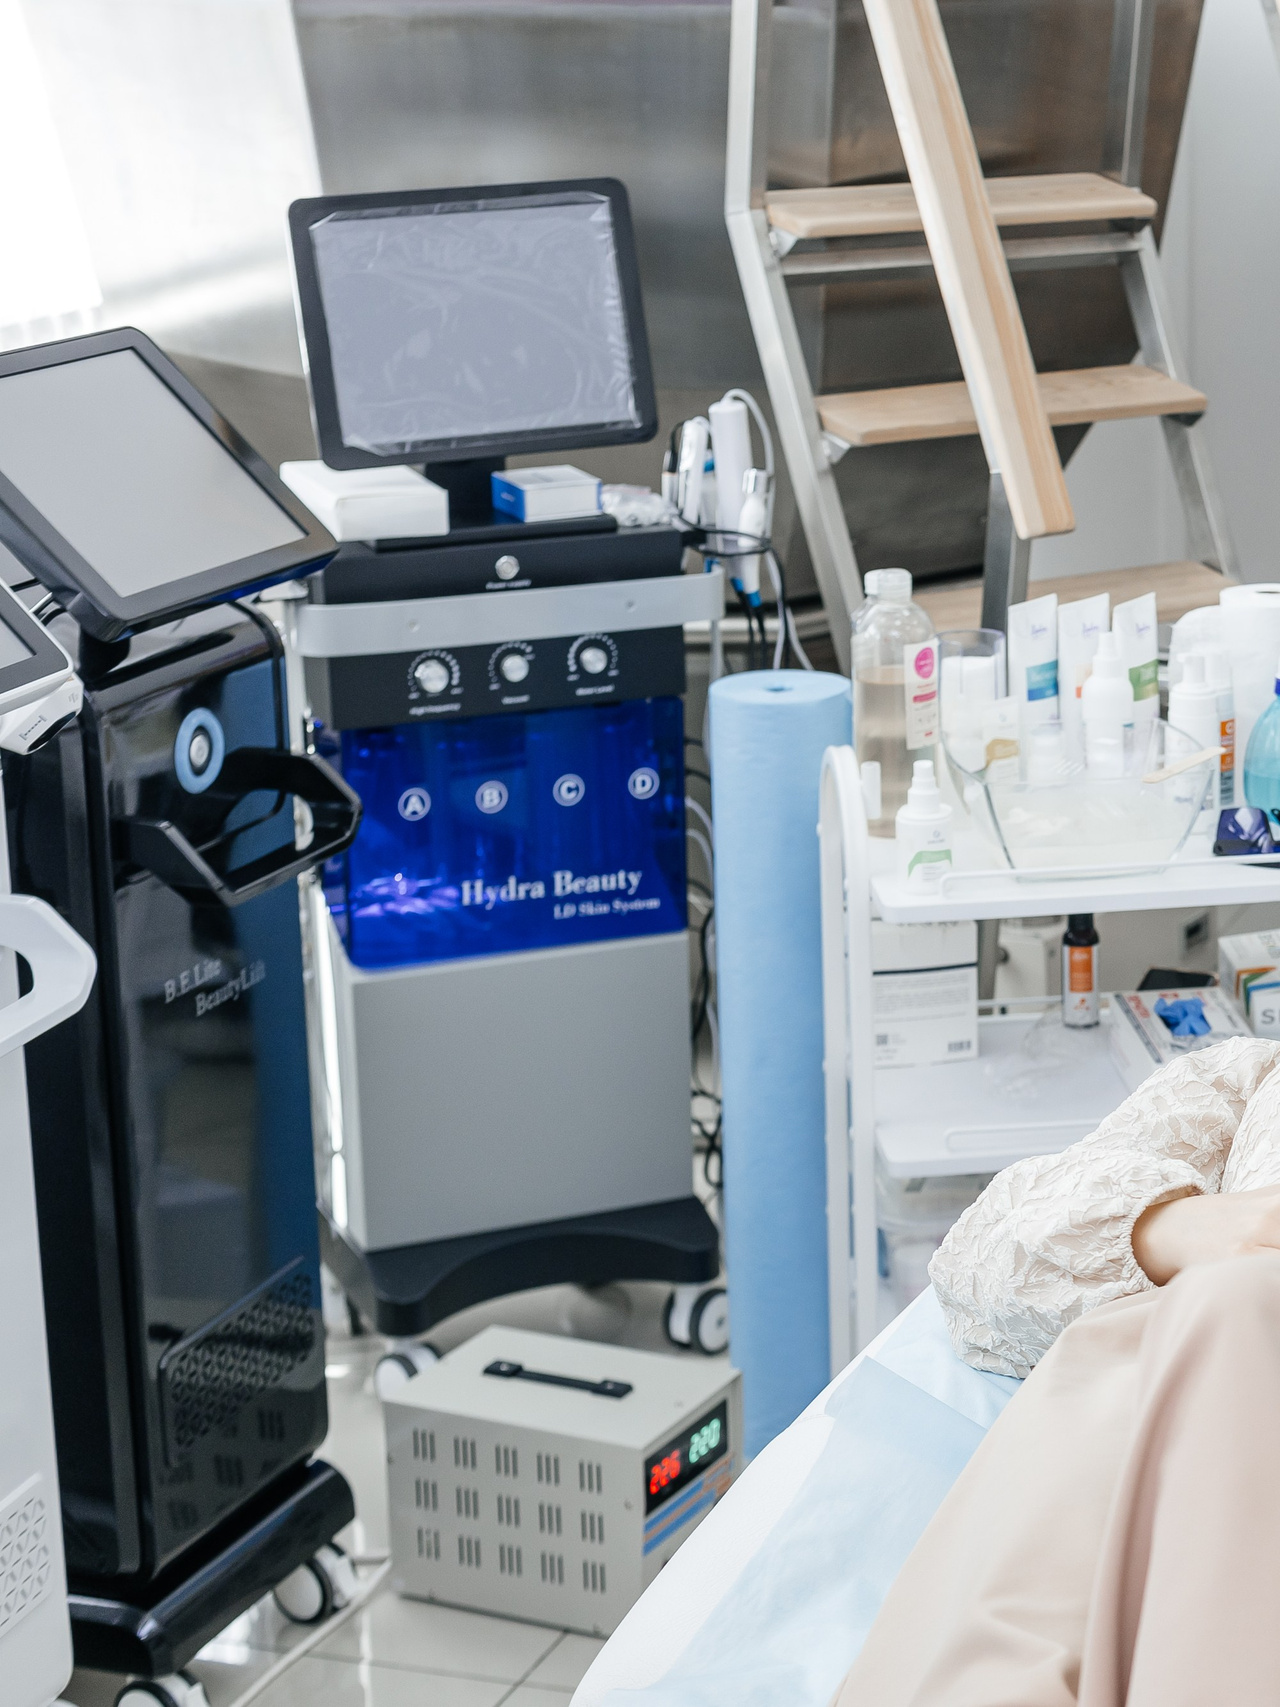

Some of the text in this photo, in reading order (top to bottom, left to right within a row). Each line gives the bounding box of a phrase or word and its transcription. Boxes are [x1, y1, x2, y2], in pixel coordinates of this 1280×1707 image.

[404, 774, 651, 816] A B C D
[461, 869, 643, 911] Hydra Beauty
[578, 901, 611, 917] Skin
[612, 898, 661, 916] System
[649, 1417, 721, 1495] 226 220
